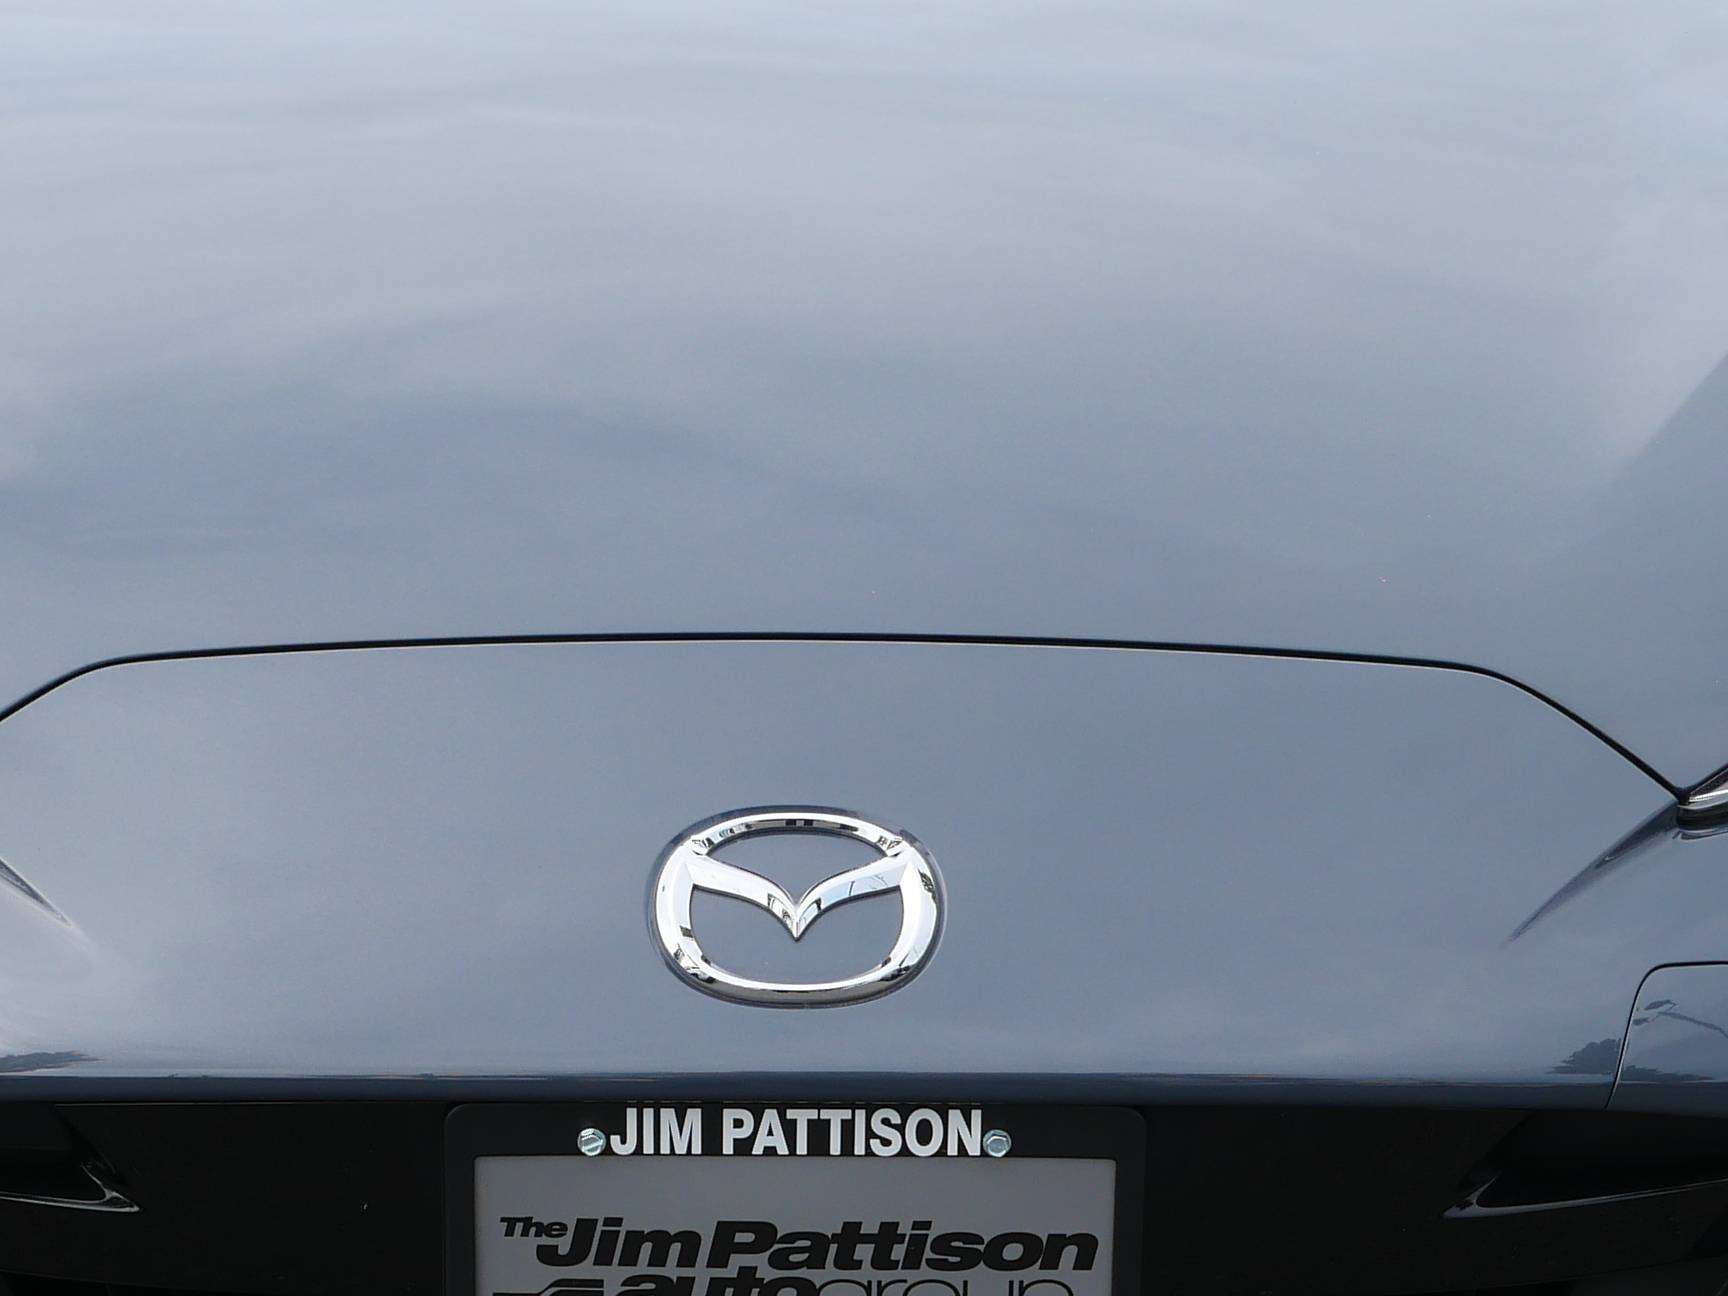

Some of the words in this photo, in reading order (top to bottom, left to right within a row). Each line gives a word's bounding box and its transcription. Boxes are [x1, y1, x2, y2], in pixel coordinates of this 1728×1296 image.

[609, 1107, 702, 1157] JIM
[722, 1107, 983, 1157] PATTISON
[500, 1216, 569, 1239] The
